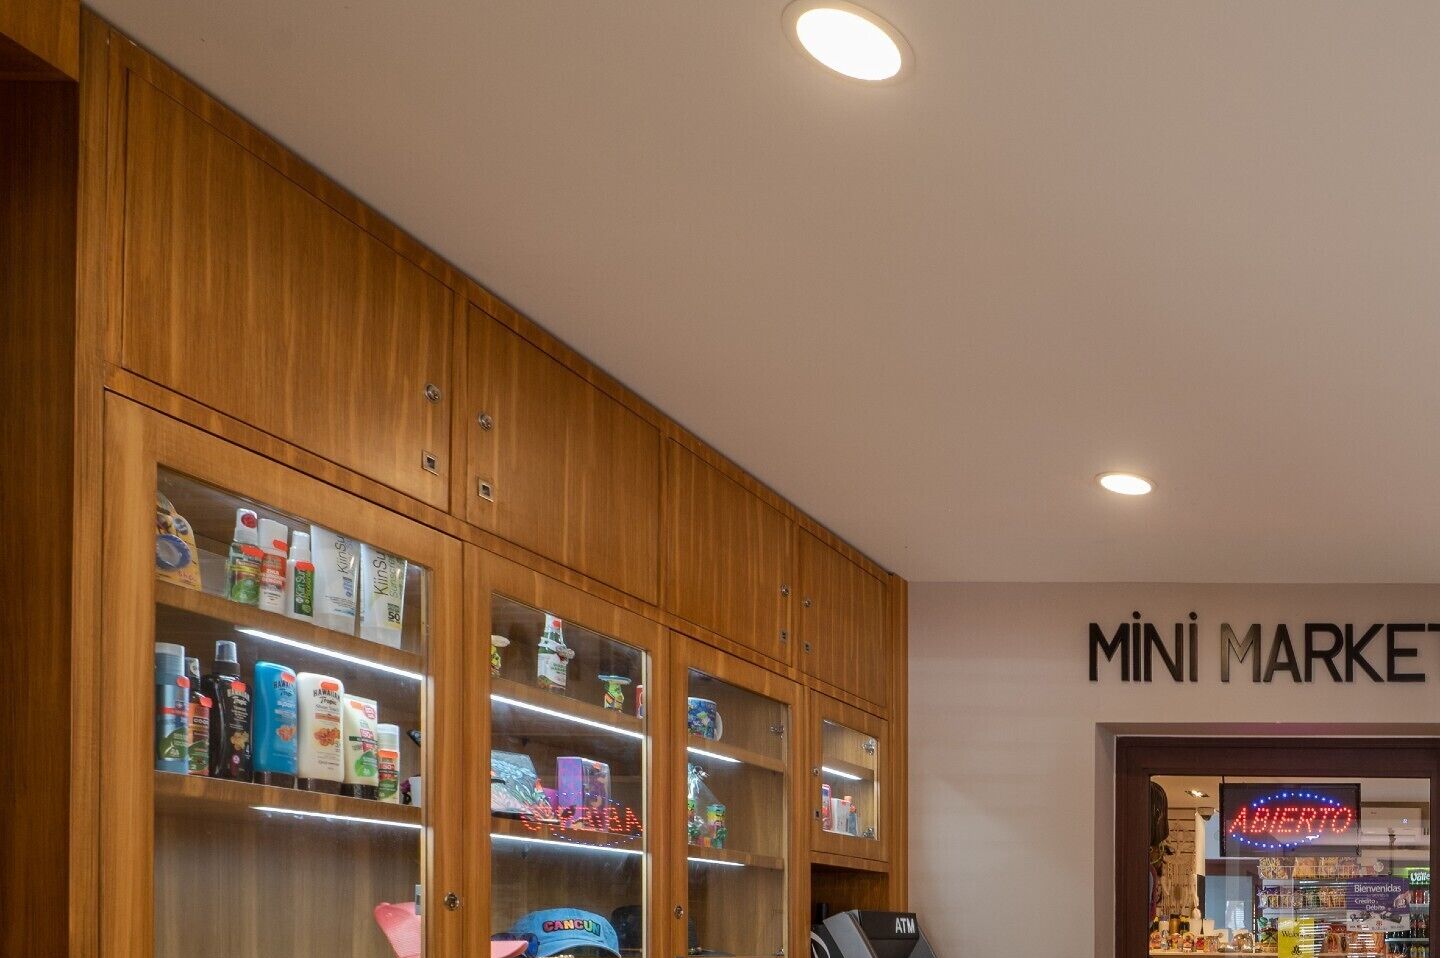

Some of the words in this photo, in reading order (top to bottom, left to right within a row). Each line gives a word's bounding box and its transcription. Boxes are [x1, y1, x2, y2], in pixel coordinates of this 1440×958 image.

[1229, 807, 1352, 833] ABIERTO
[1354, 884, 1402, 893] Bienvenidas
[543, 920, 601, 937] CANCUN
[895, 917, 916, 934] ATM
